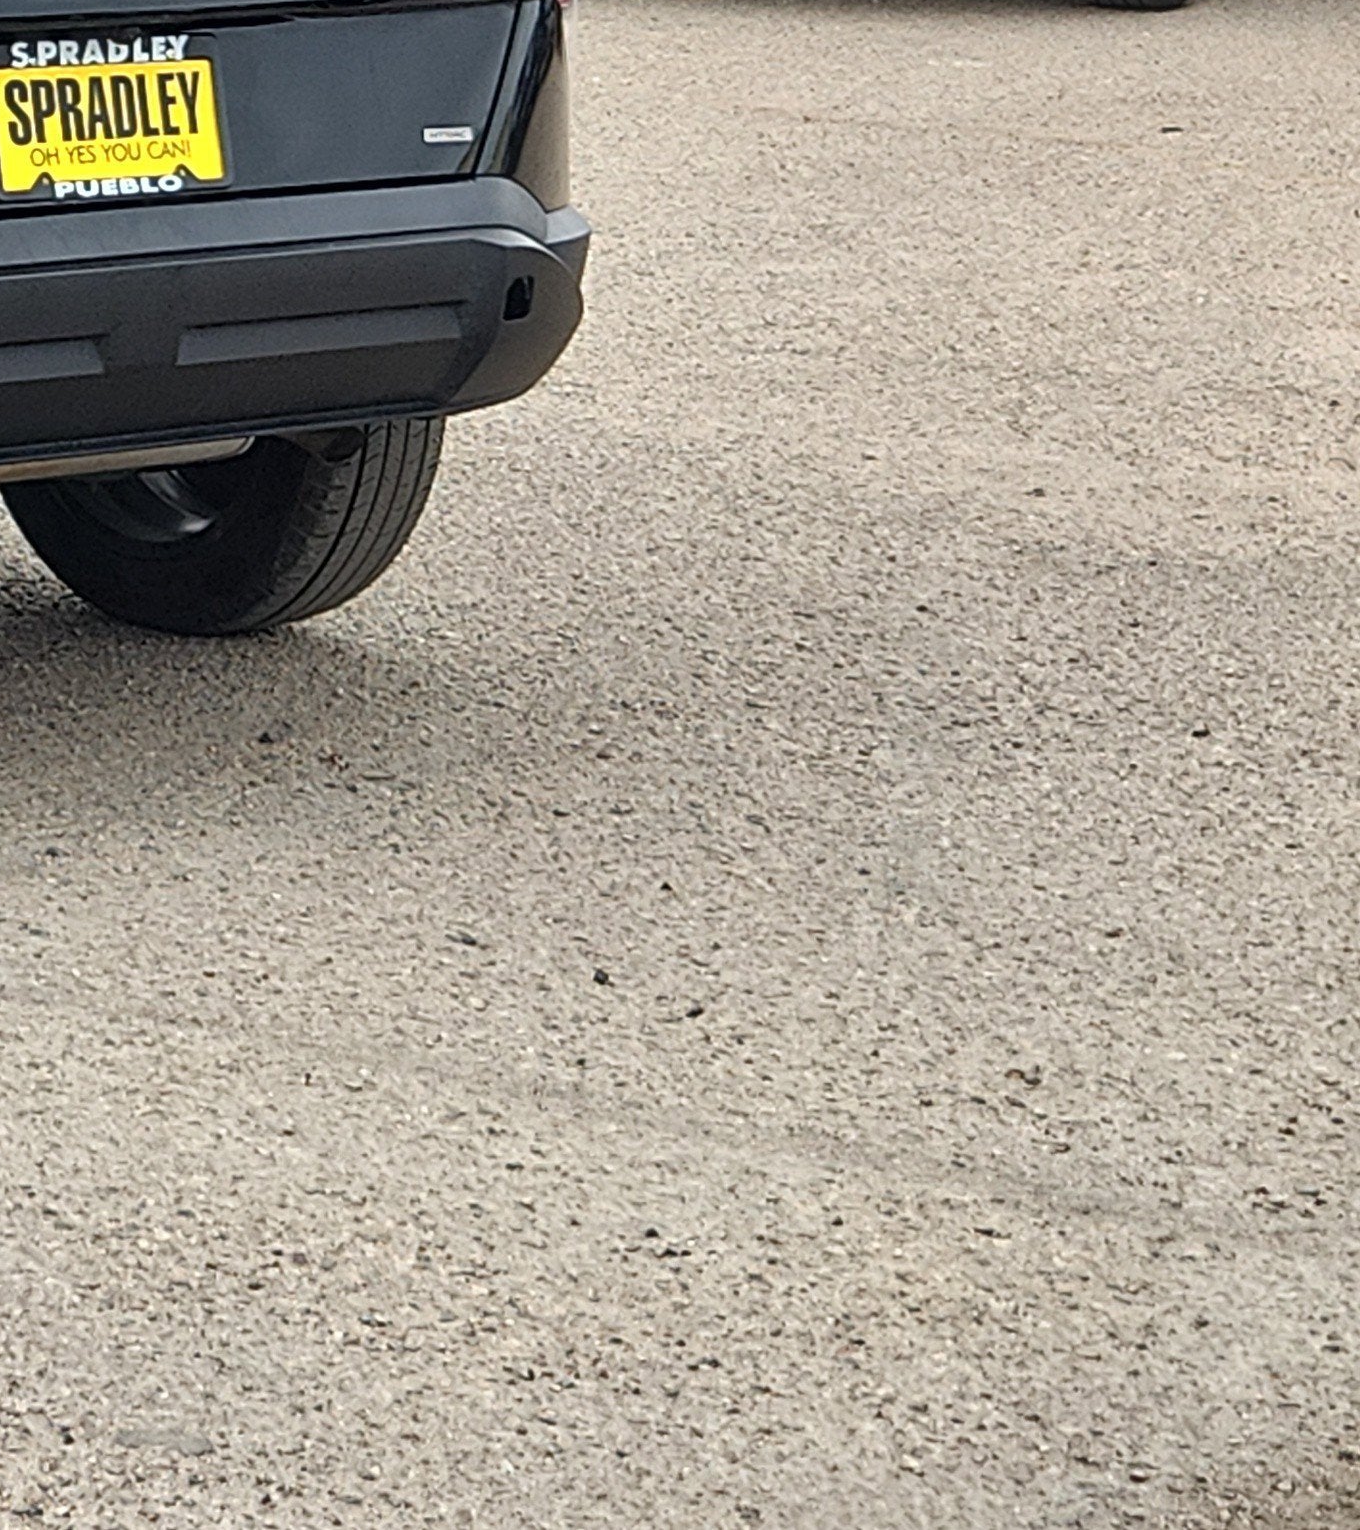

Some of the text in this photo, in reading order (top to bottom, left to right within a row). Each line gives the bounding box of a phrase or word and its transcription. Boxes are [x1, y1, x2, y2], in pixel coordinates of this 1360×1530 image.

[10, 35, 189, 68] SPRADLEY
[4, 71, 200, 146] SPRADLEY
[30, 139, 191, 167] OH YES YOU CAN!
[54, 175, 184, 198] PUEBLO
